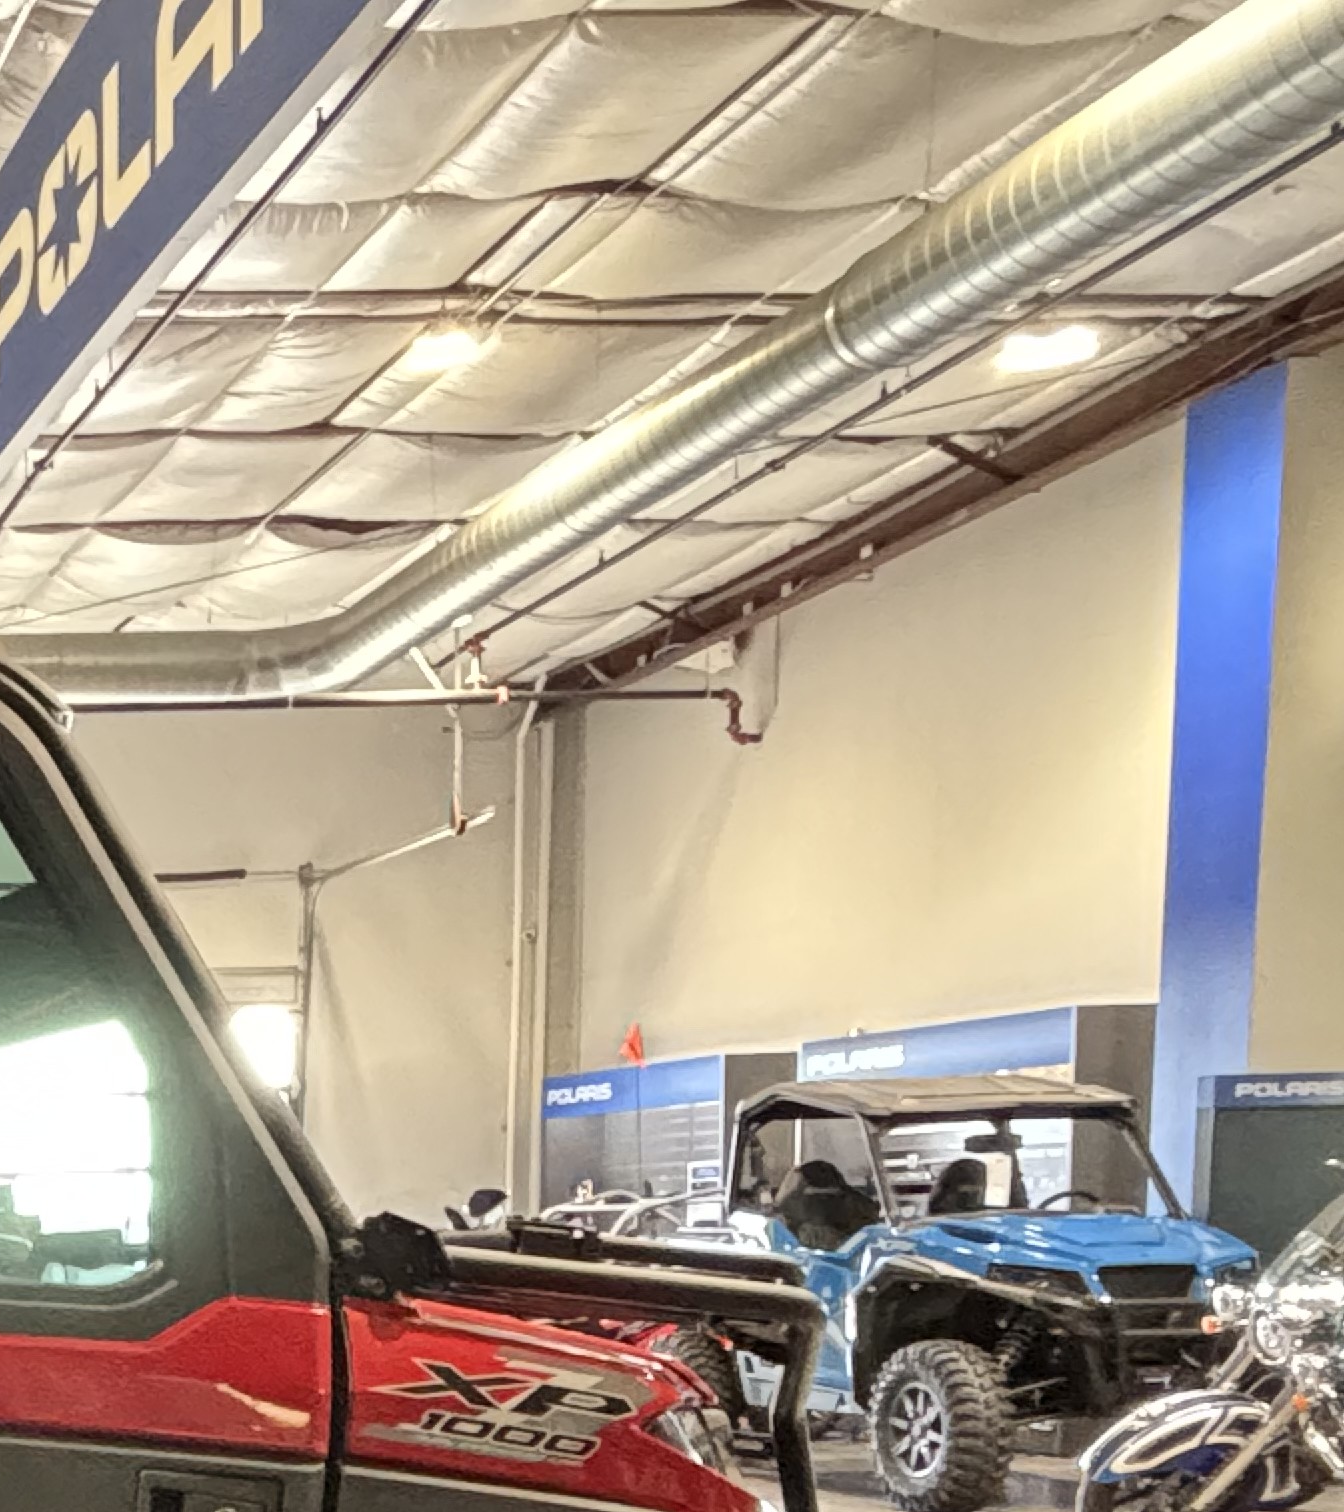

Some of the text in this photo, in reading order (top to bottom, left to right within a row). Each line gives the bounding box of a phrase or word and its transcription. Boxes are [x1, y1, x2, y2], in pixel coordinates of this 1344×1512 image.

[546, 1082, 613, 1106] POLARIS
[367, 1357, 638, 1421] XP
[419, 1411, 601, 1461] 1000
